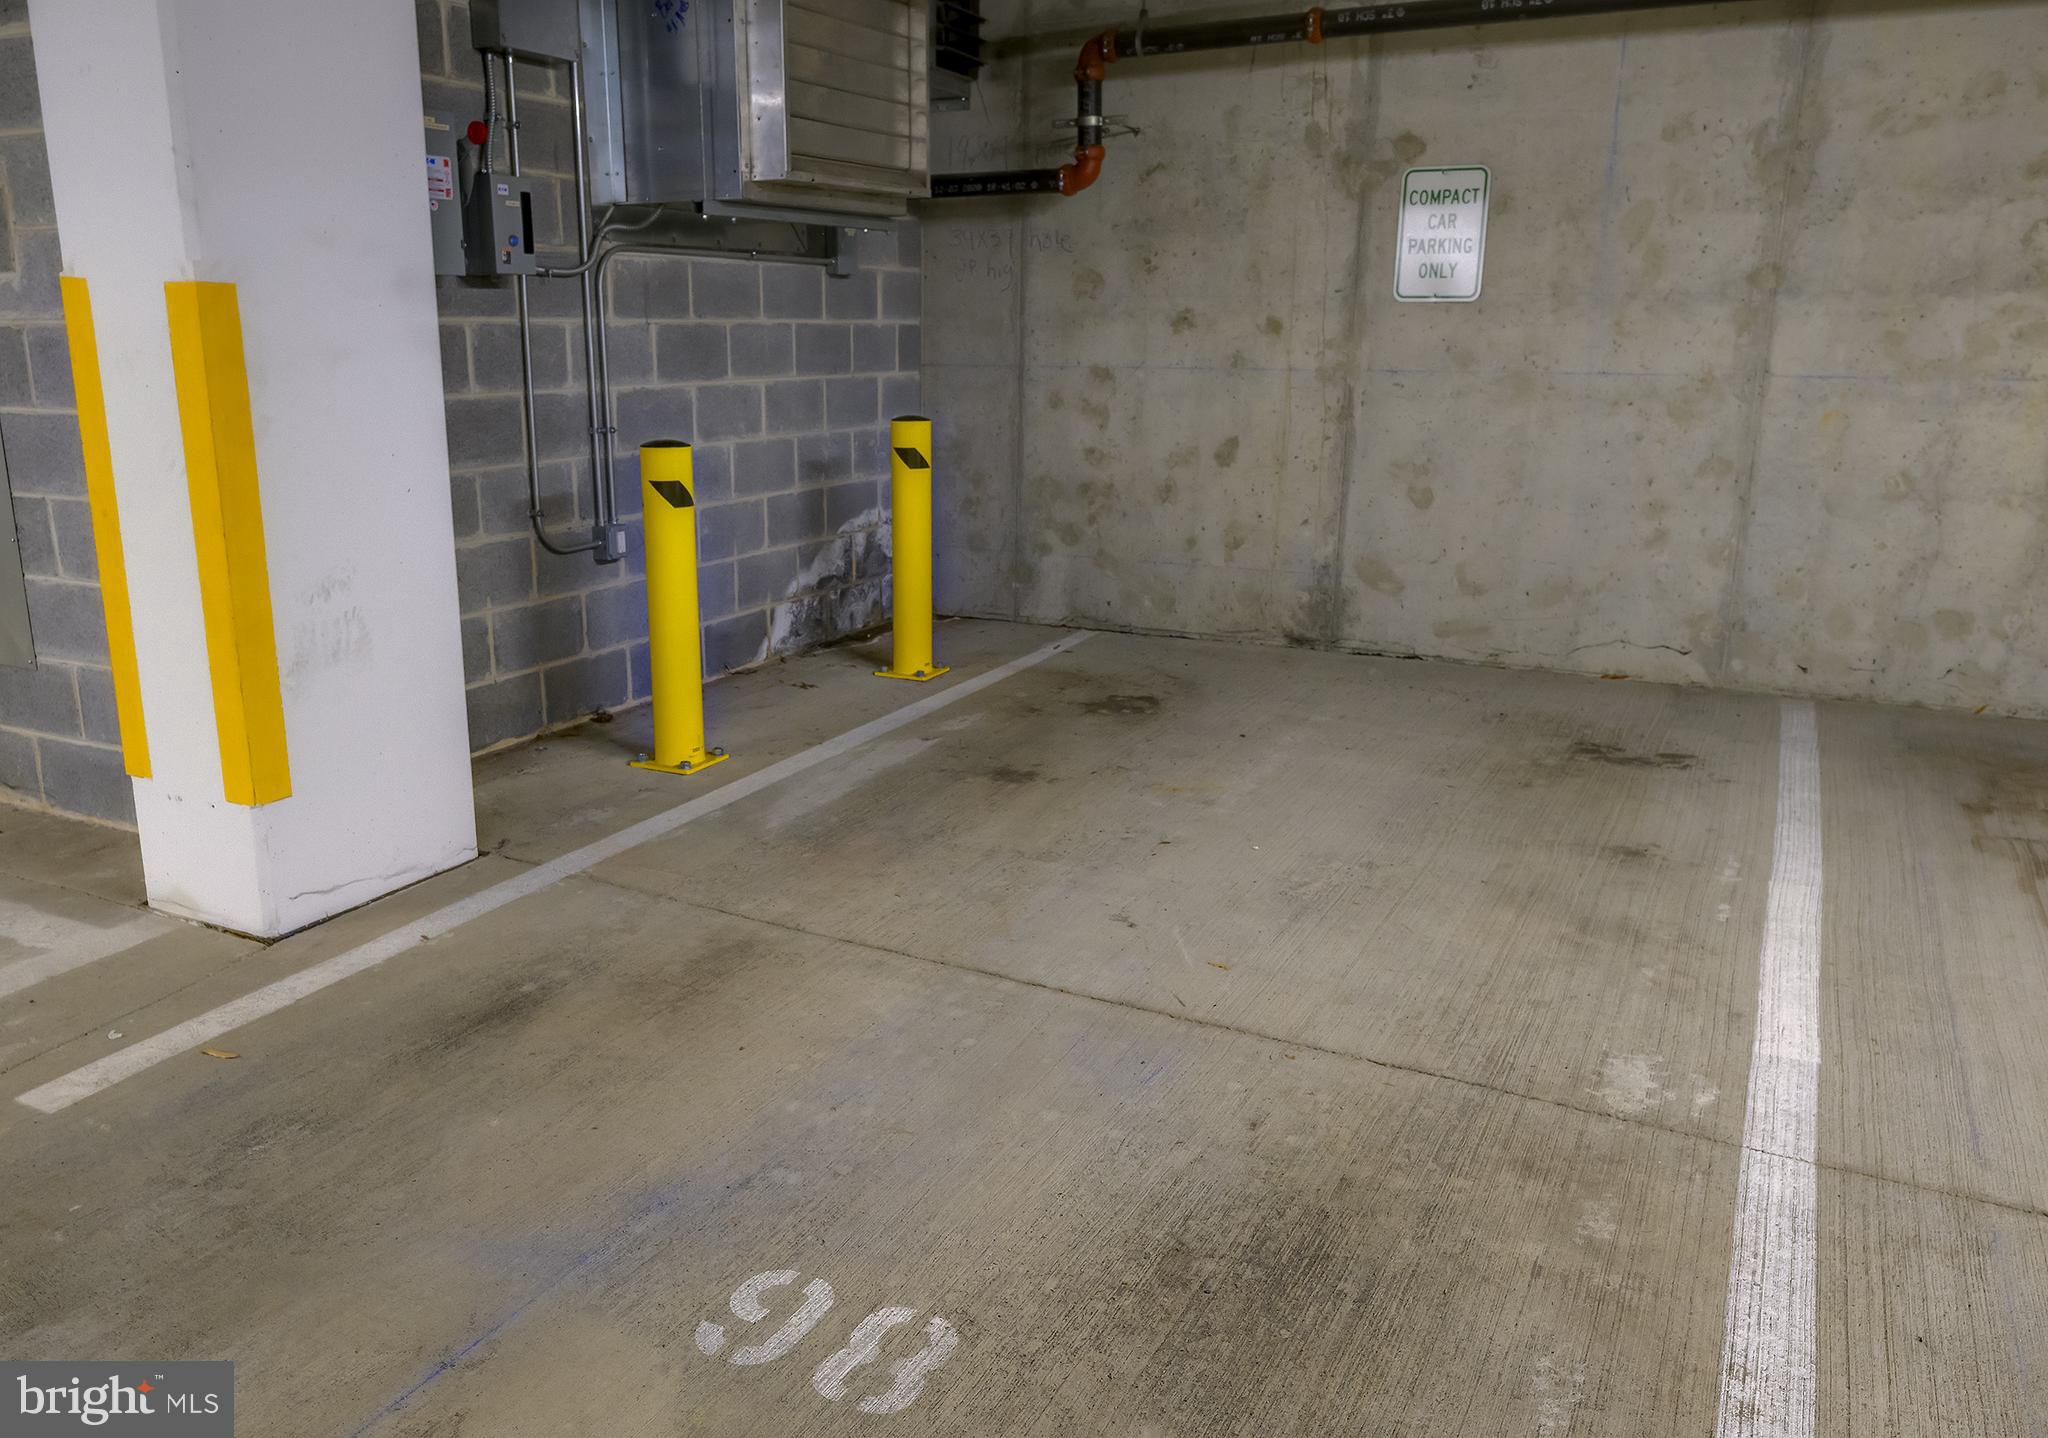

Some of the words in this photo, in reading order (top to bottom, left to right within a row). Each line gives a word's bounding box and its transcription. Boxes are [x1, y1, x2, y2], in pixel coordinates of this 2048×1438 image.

[1409, 187, 1480, 206] COMPACT
[1428, 213, 1457, 230] CAR
[1407, 237, 1473, 255] PARKING
[1418, 261, 1458, 279] ONLY
[695, 1269, 960, 1415] 98
